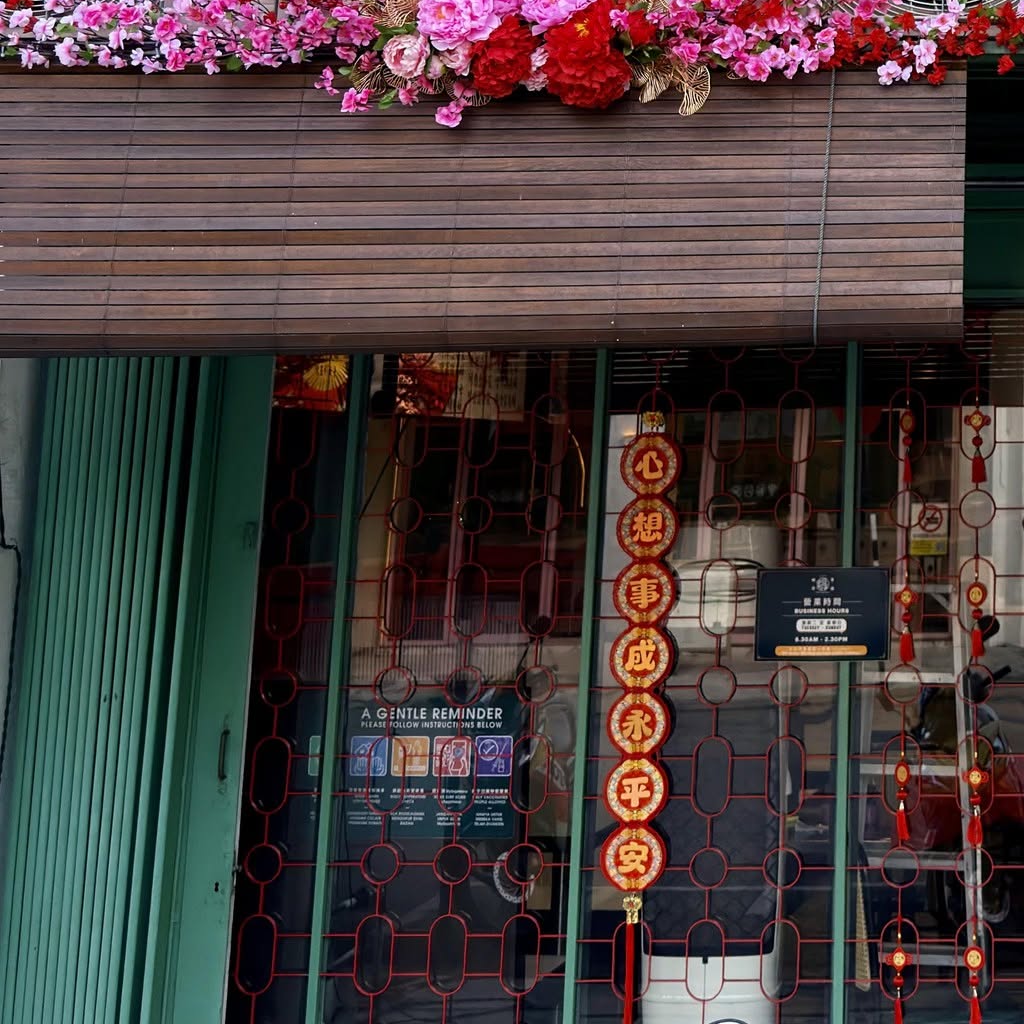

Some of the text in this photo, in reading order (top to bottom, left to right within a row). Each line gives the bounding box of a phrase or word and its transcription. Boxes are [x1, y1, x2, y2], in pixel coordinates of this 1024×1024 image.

[361, 707, 503, 720] A GENTLE REMINDER
